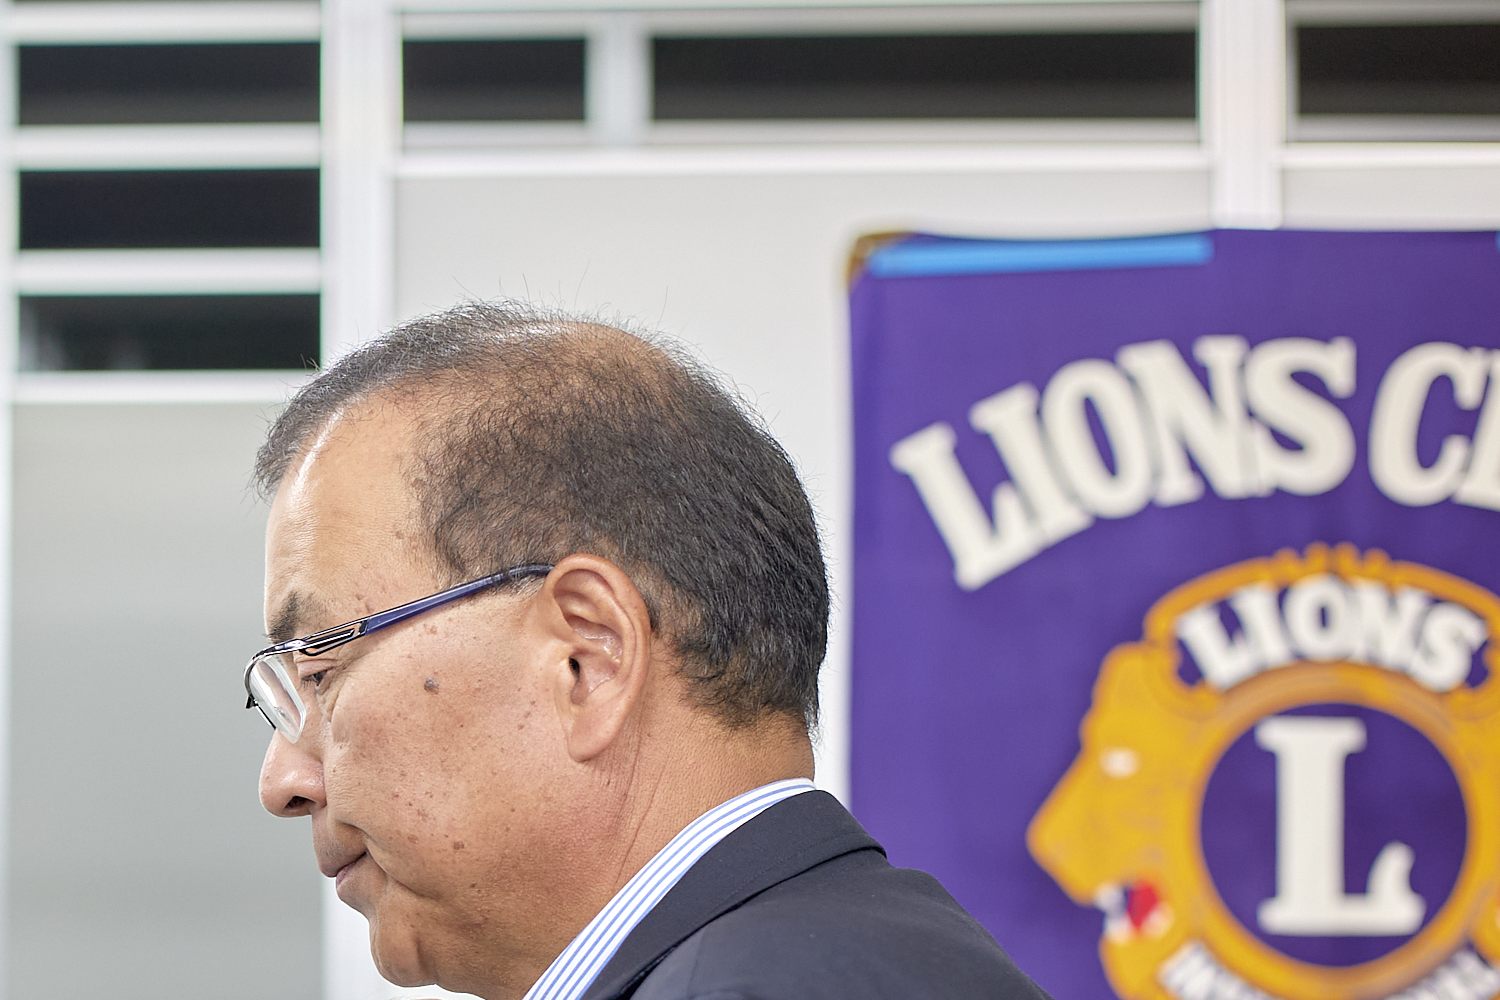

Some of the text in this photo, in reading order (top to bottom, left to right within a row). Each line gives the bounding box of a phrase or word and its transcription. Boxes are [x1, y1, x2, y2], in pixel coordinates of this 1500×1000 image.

[891, 335, 1357, 590] LIONS
[1176, 573, 1488, 692] LIONS
[1255, 716, 1426, 937] L
